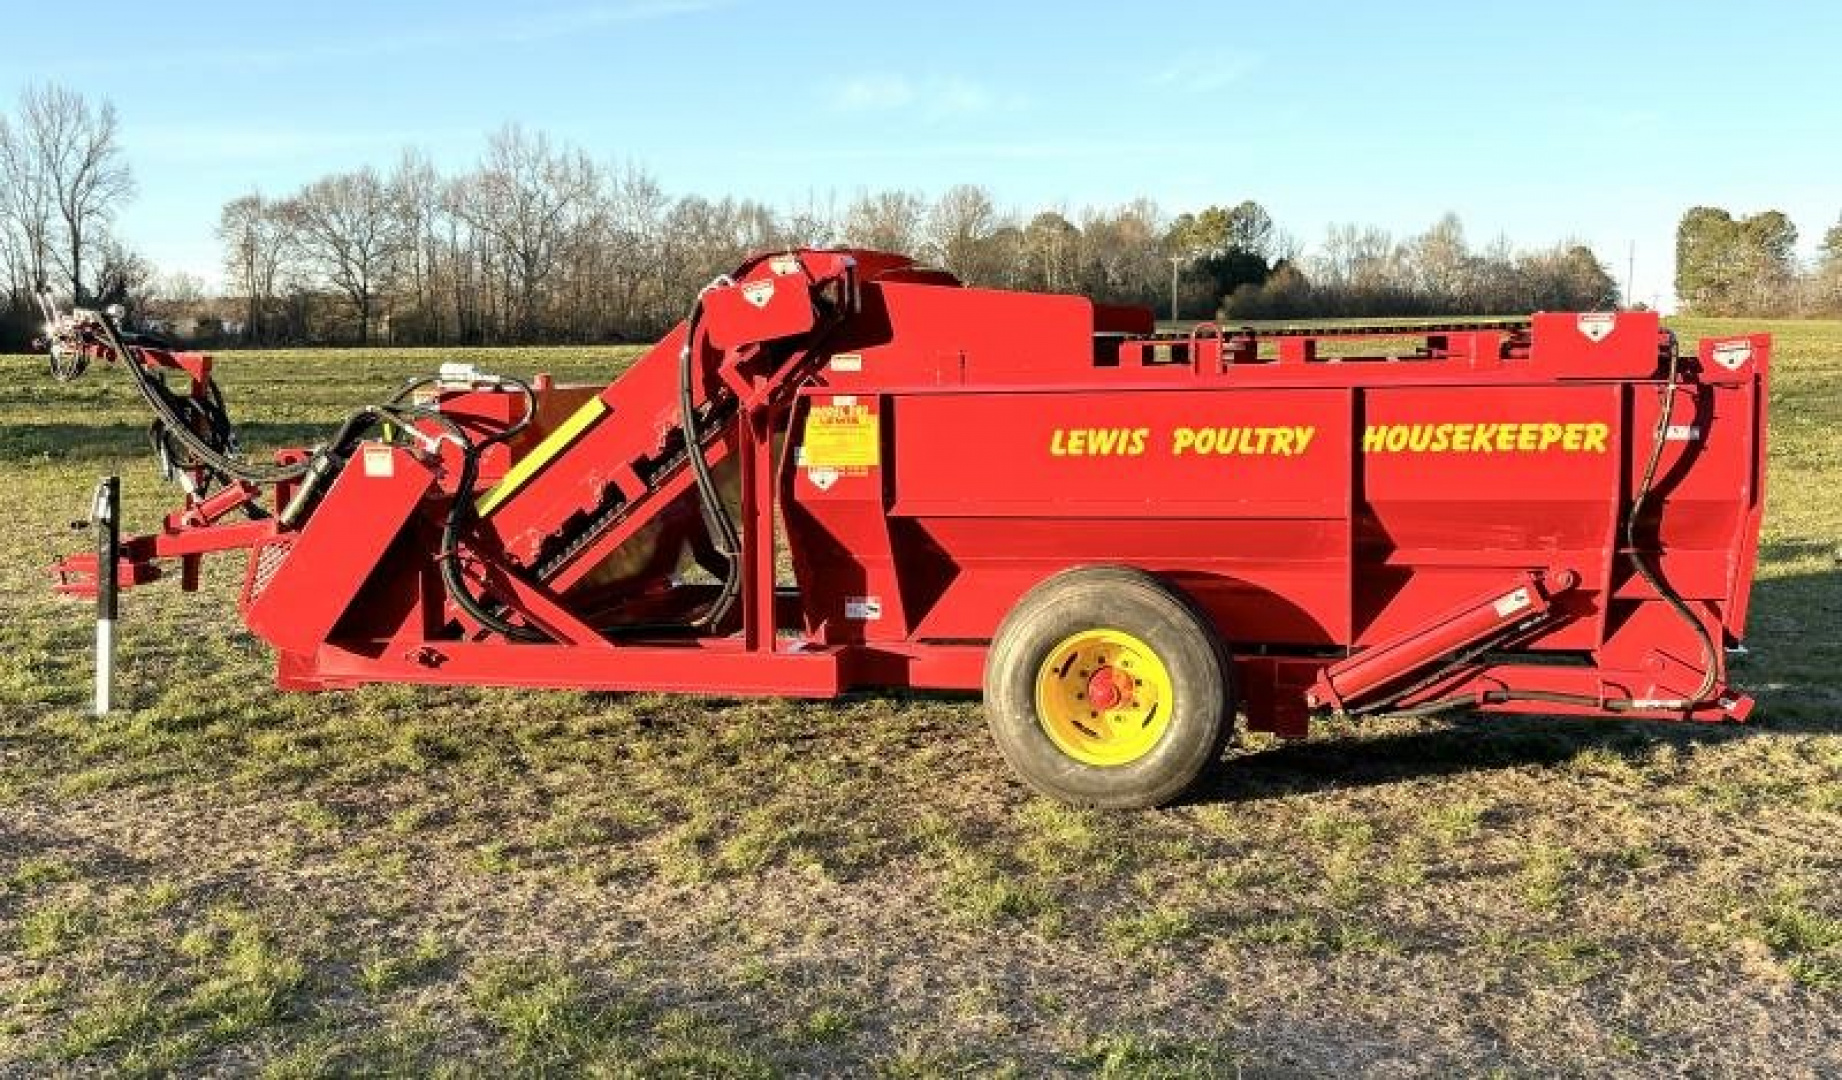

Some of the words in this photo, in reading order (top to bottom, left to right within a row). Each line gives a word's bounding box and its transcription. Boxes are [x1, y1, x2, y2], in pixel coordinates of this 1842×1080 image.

[1049, 428, 1149, 456] LEWIS
[1173, 426, 1315, 456] POULTRY
[1362, 422, 1608, 453] HOUSEKEEPER
